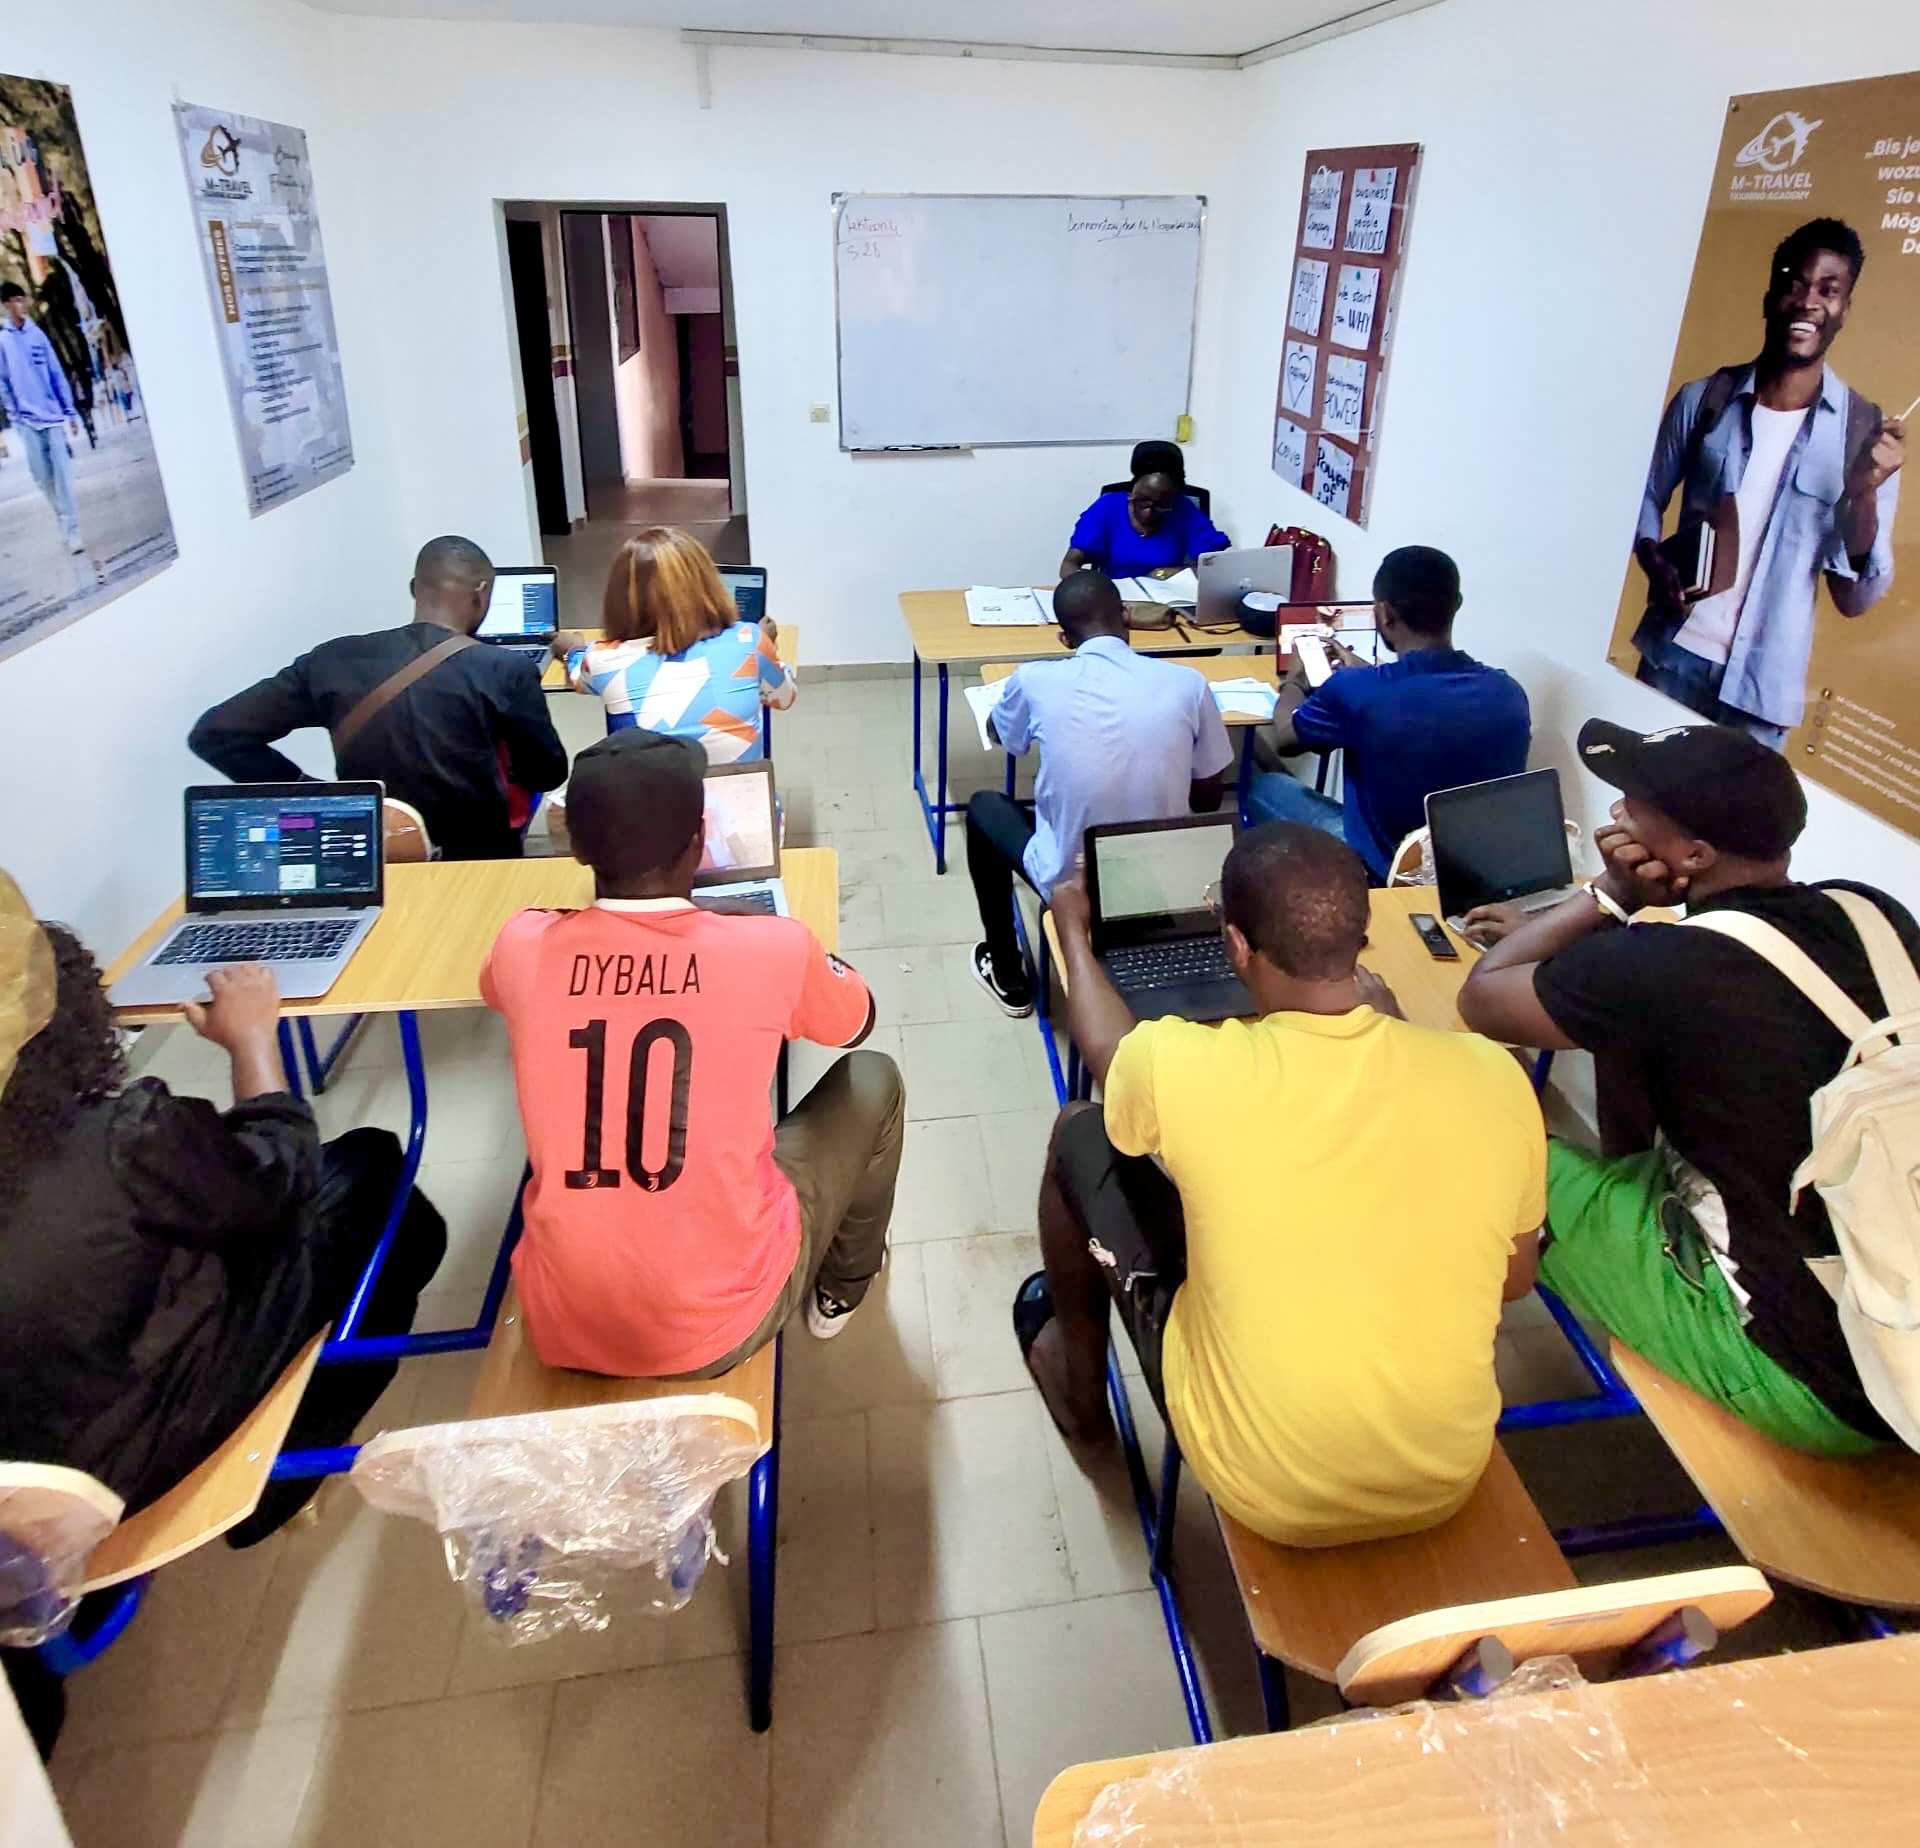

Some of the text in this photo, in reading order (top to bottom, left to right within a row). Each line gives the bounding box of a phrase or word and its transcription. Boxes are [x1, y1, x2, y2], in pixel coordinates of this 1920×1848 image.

[1730, 172, 1813, 190] M-TRAVEL
[1885, 186, 1914, 204] Sie
[1348, 309, 1370, 333] WHY
[568, 953, 701, 996] DYBALA
[565, 1017, 693, 1192] 10
